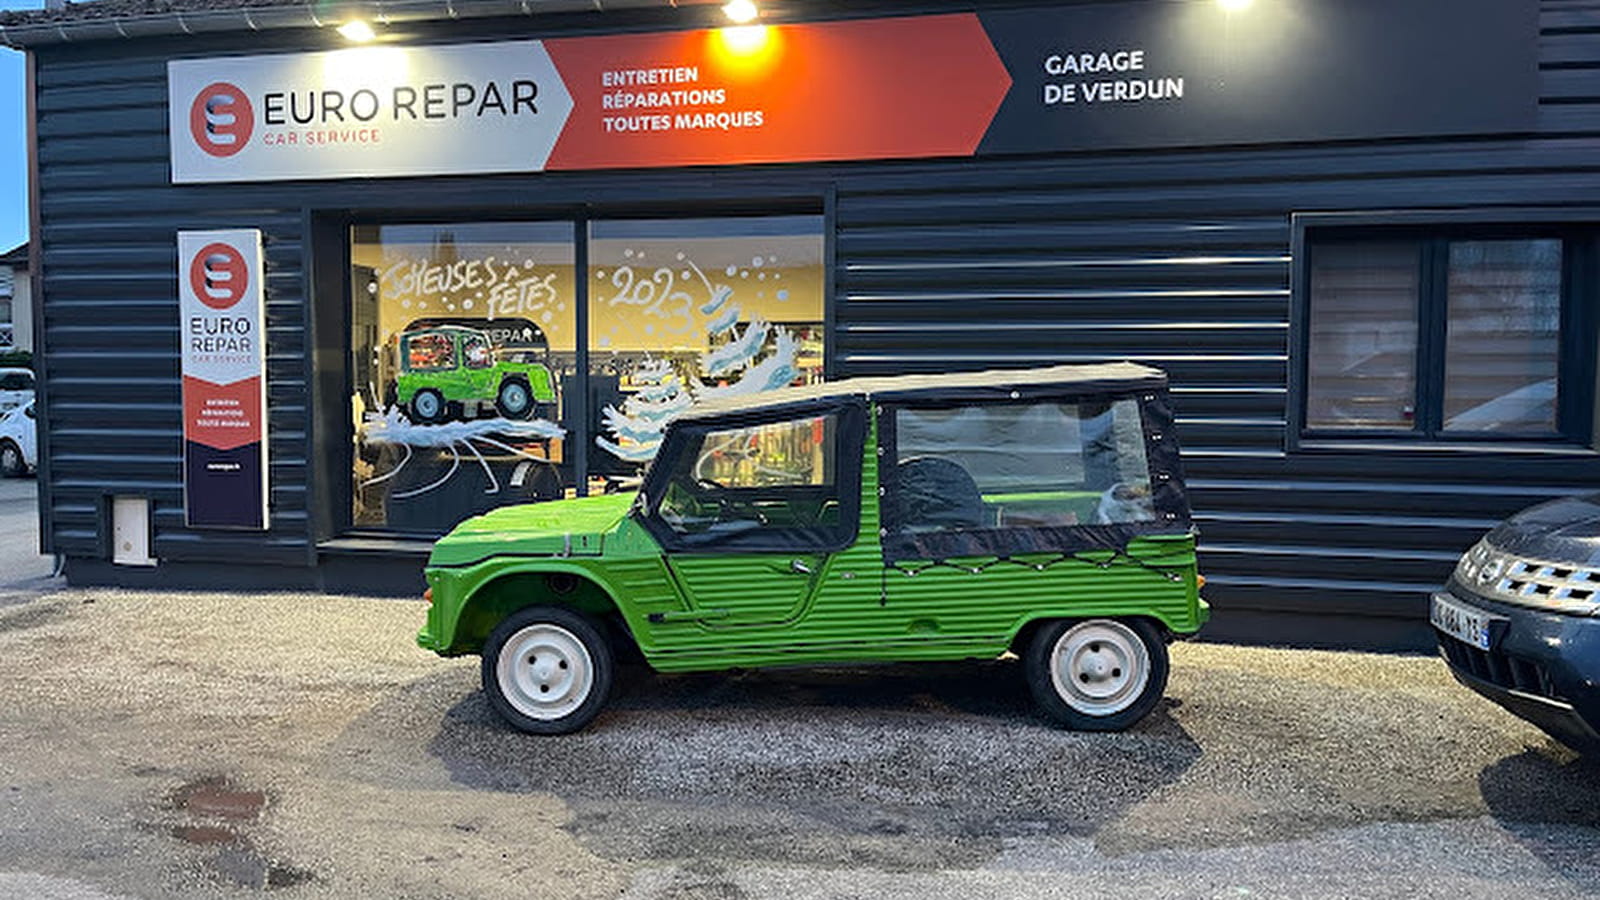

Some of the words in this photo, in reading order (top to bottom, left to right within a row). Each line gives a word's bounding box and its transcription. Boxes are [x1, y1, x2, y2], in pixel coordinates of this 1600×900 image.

[1044, 50, 1144, 75] GARAGE
[602, 66, 698, 87] ENTRETIEN
[602, 89, 726, 109] RÉPARATIONS
[1044, 84, 1076, 104] DE
[1081, 77, 1184, 102] VERDUN
[264, 89, 379, 125] EURO
[393, 80, 539, 120] REPAR
[603, 115, 671, 132] TOUTES
[674, 111, 764, 130] MARQUES
[264, 132, 298, 146] CAR
[305, 129, 381, 145] SERVICE
[382, 256, 498, 299] JOYEUSES
[608, 266, 694, 334] 2023
[191, 317, 251, 335] EURO
[191, 337, 252, 352] REPAR
